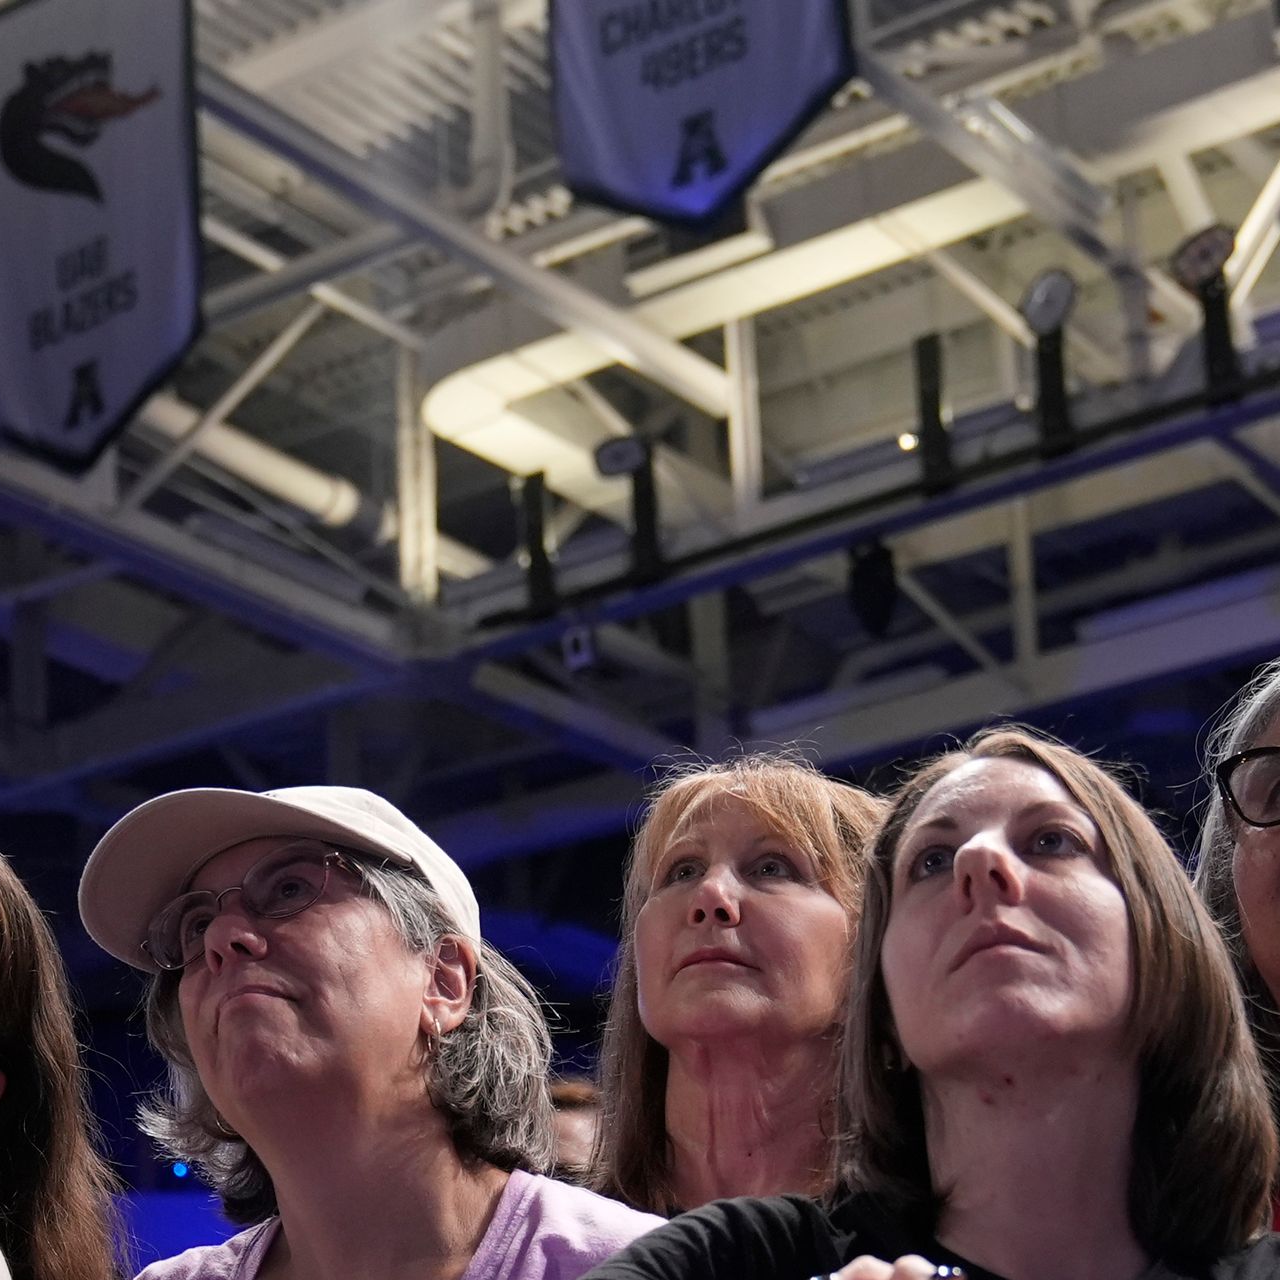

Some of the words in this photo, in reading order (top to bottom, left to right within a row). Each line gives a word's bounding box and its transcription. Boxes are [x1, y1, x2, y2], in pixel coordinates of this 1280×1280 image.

[640, 14, 750, 93] 49ERS
[666, 106, 729, 190] A
[27, 267, 138, 351] BLAZERS
[62, 356, 105, 430] A
